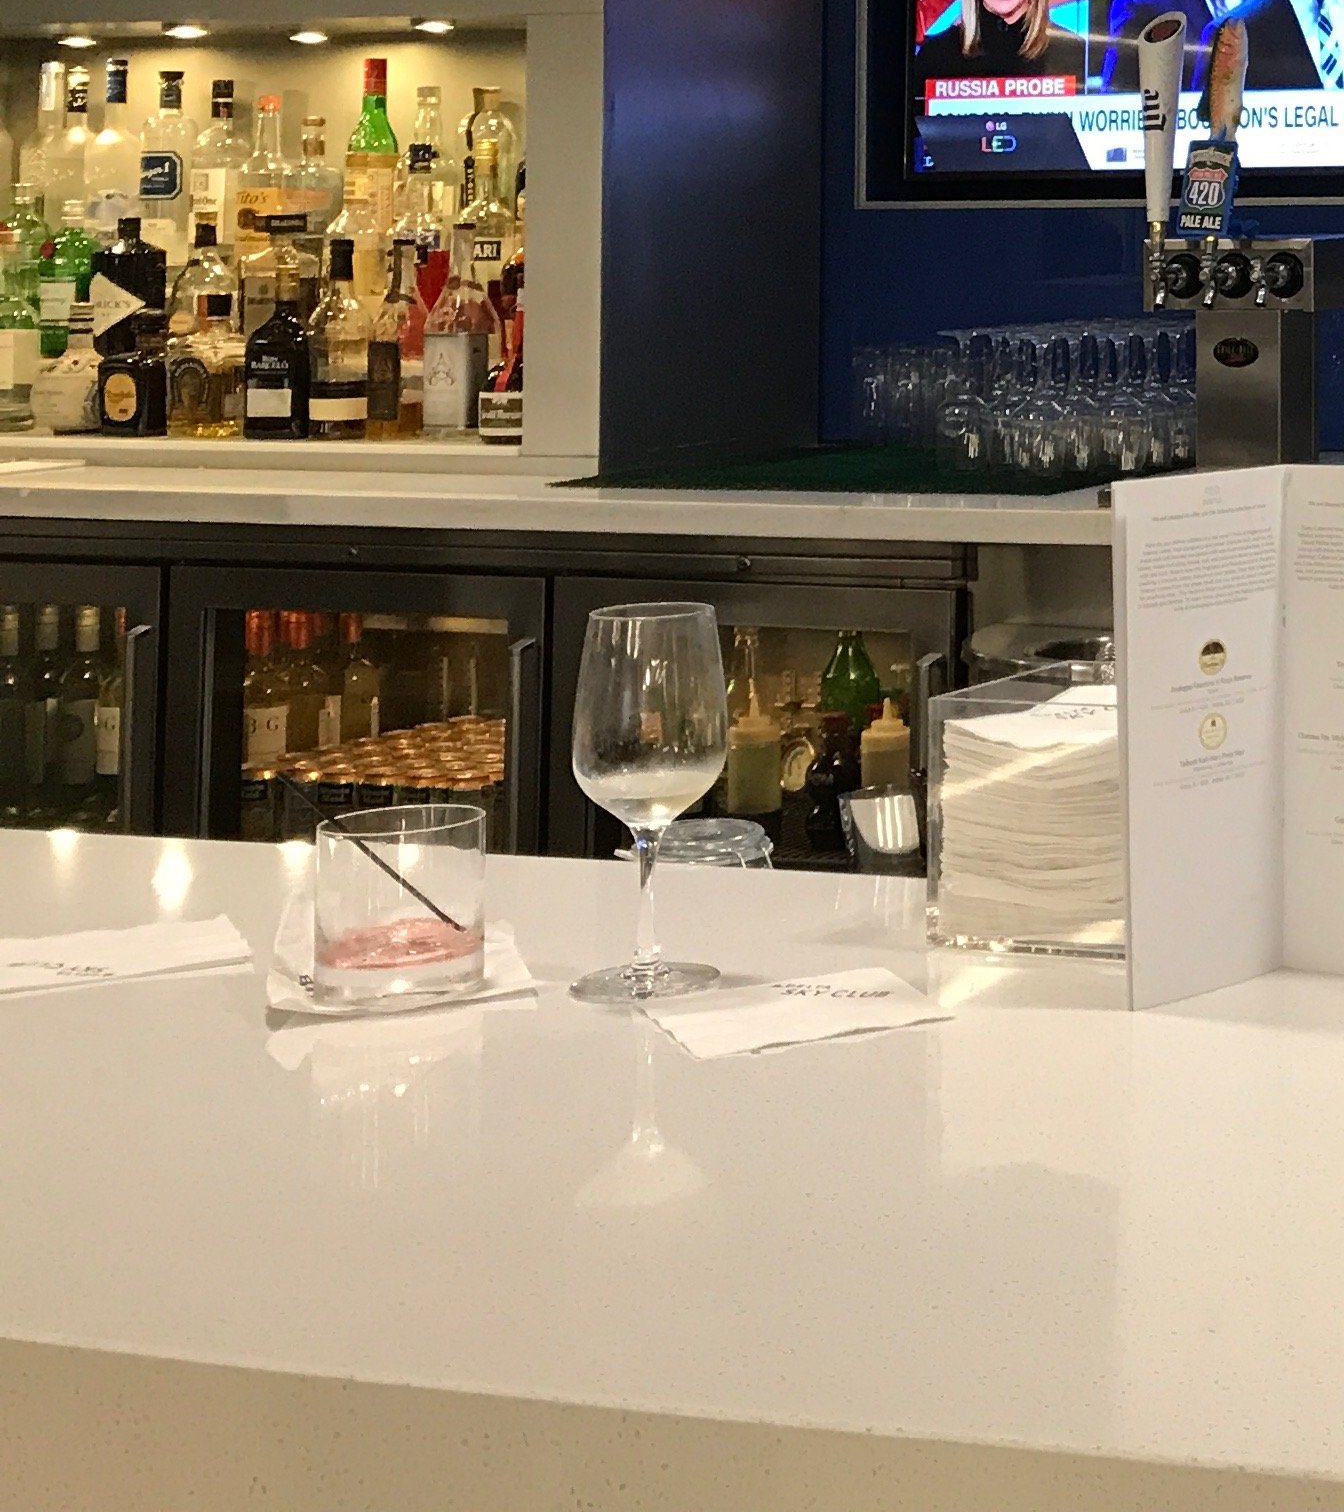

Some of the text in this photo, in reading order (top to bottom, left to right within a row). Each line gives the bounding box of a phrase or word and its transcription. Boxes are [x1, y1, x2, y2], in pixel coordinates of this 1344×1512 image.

[935, 77, 1065, 97] RUSSIA PROBE
[1079, 109, 1144, 132] WORRIE
[1238, 106, 1278, 129] ON'S
[1284, 104, 1335, 128] LEGAL
[1188, 181, 1220, 207] 420
[1180, 214, 1222, 229] PALE ALE
